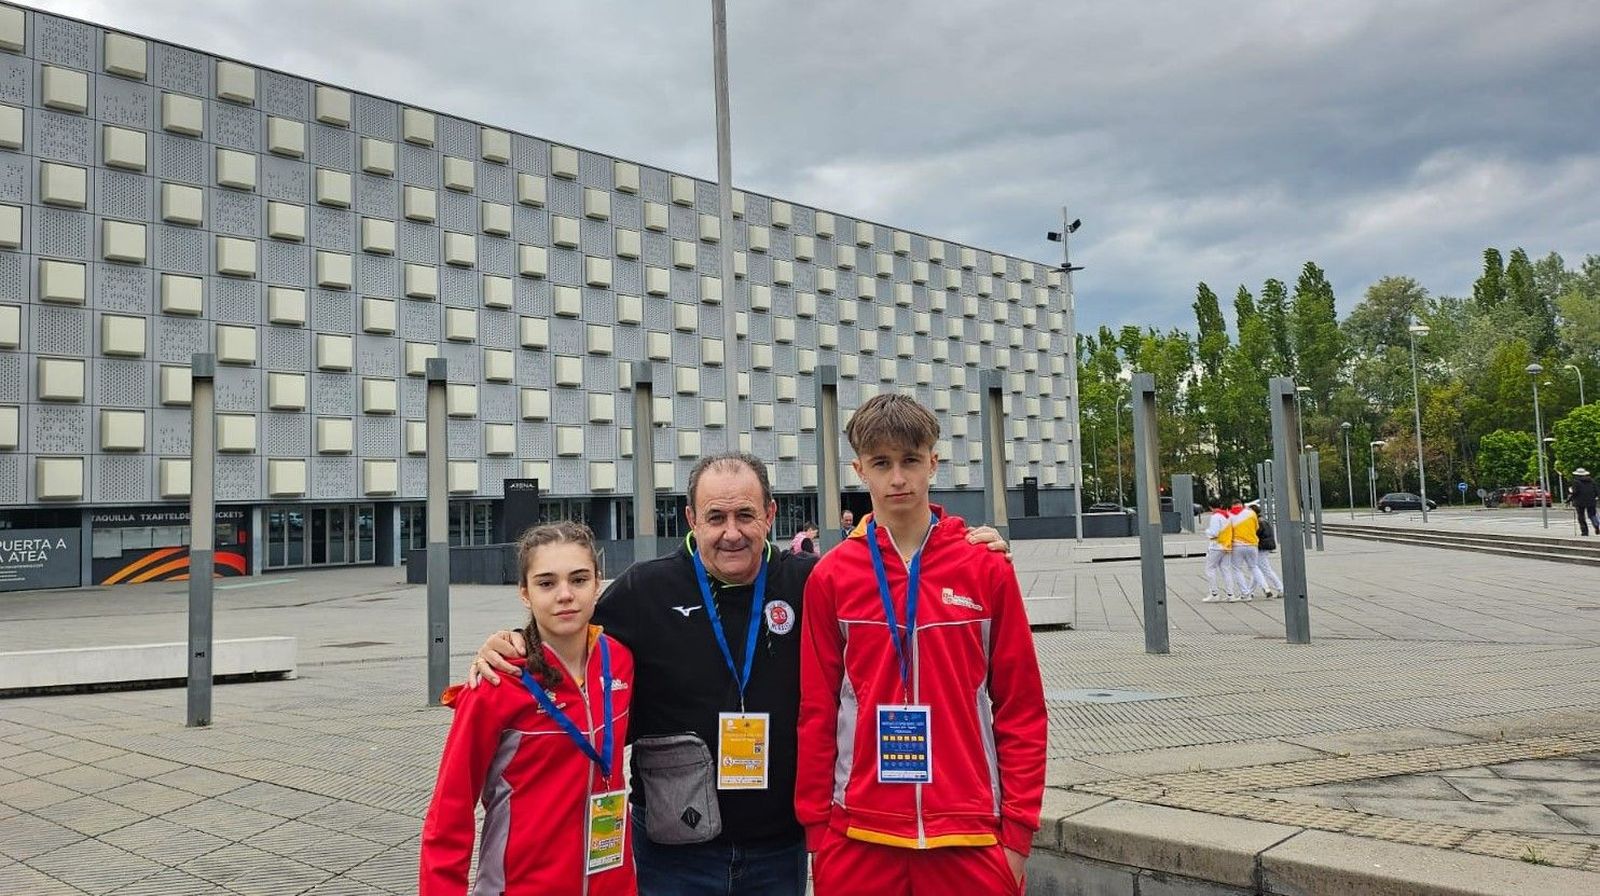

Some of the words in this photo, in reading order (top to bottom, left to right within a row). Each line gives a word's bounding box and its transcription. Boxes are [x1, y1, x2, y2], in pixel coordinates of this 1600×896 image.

[140, 512, 192, 521] TXARTELDE
[215, 511, 245, 519] ICKETS
[56, 538, 67, 549] A
[8, 551, 48, 562] ATEA
